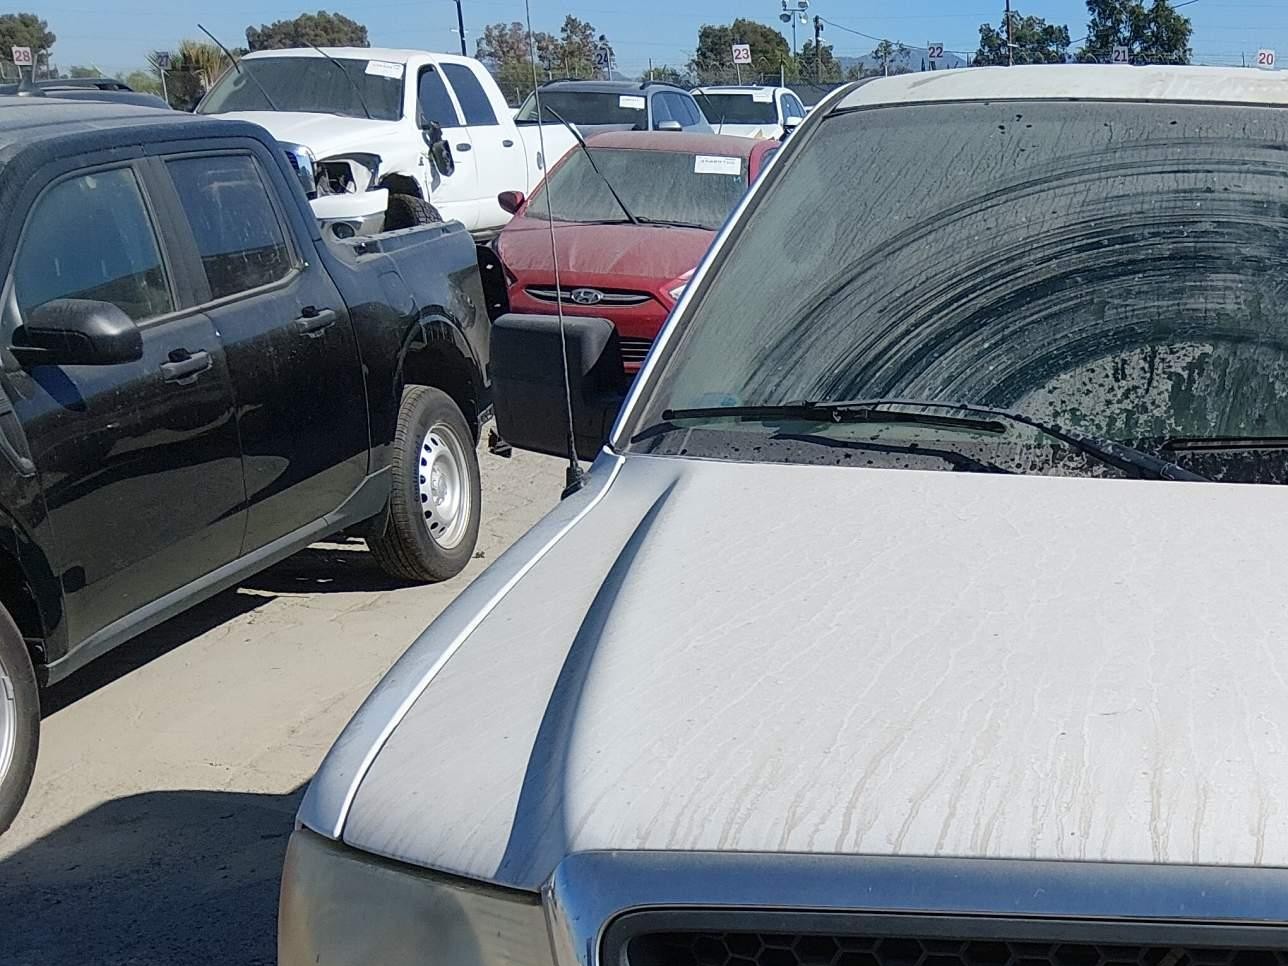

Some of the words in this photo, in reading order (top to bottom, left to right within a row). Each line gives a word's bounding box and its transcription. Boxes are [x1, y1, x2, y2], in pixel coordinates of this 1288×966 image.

[14, 49, 31, 62] 28
[733, 48, 750, 60] 23
[928, 46, 944, 58] 22
[1113, 49, 1128, 61] 21
[1258, 52, 1275, 65] 20
